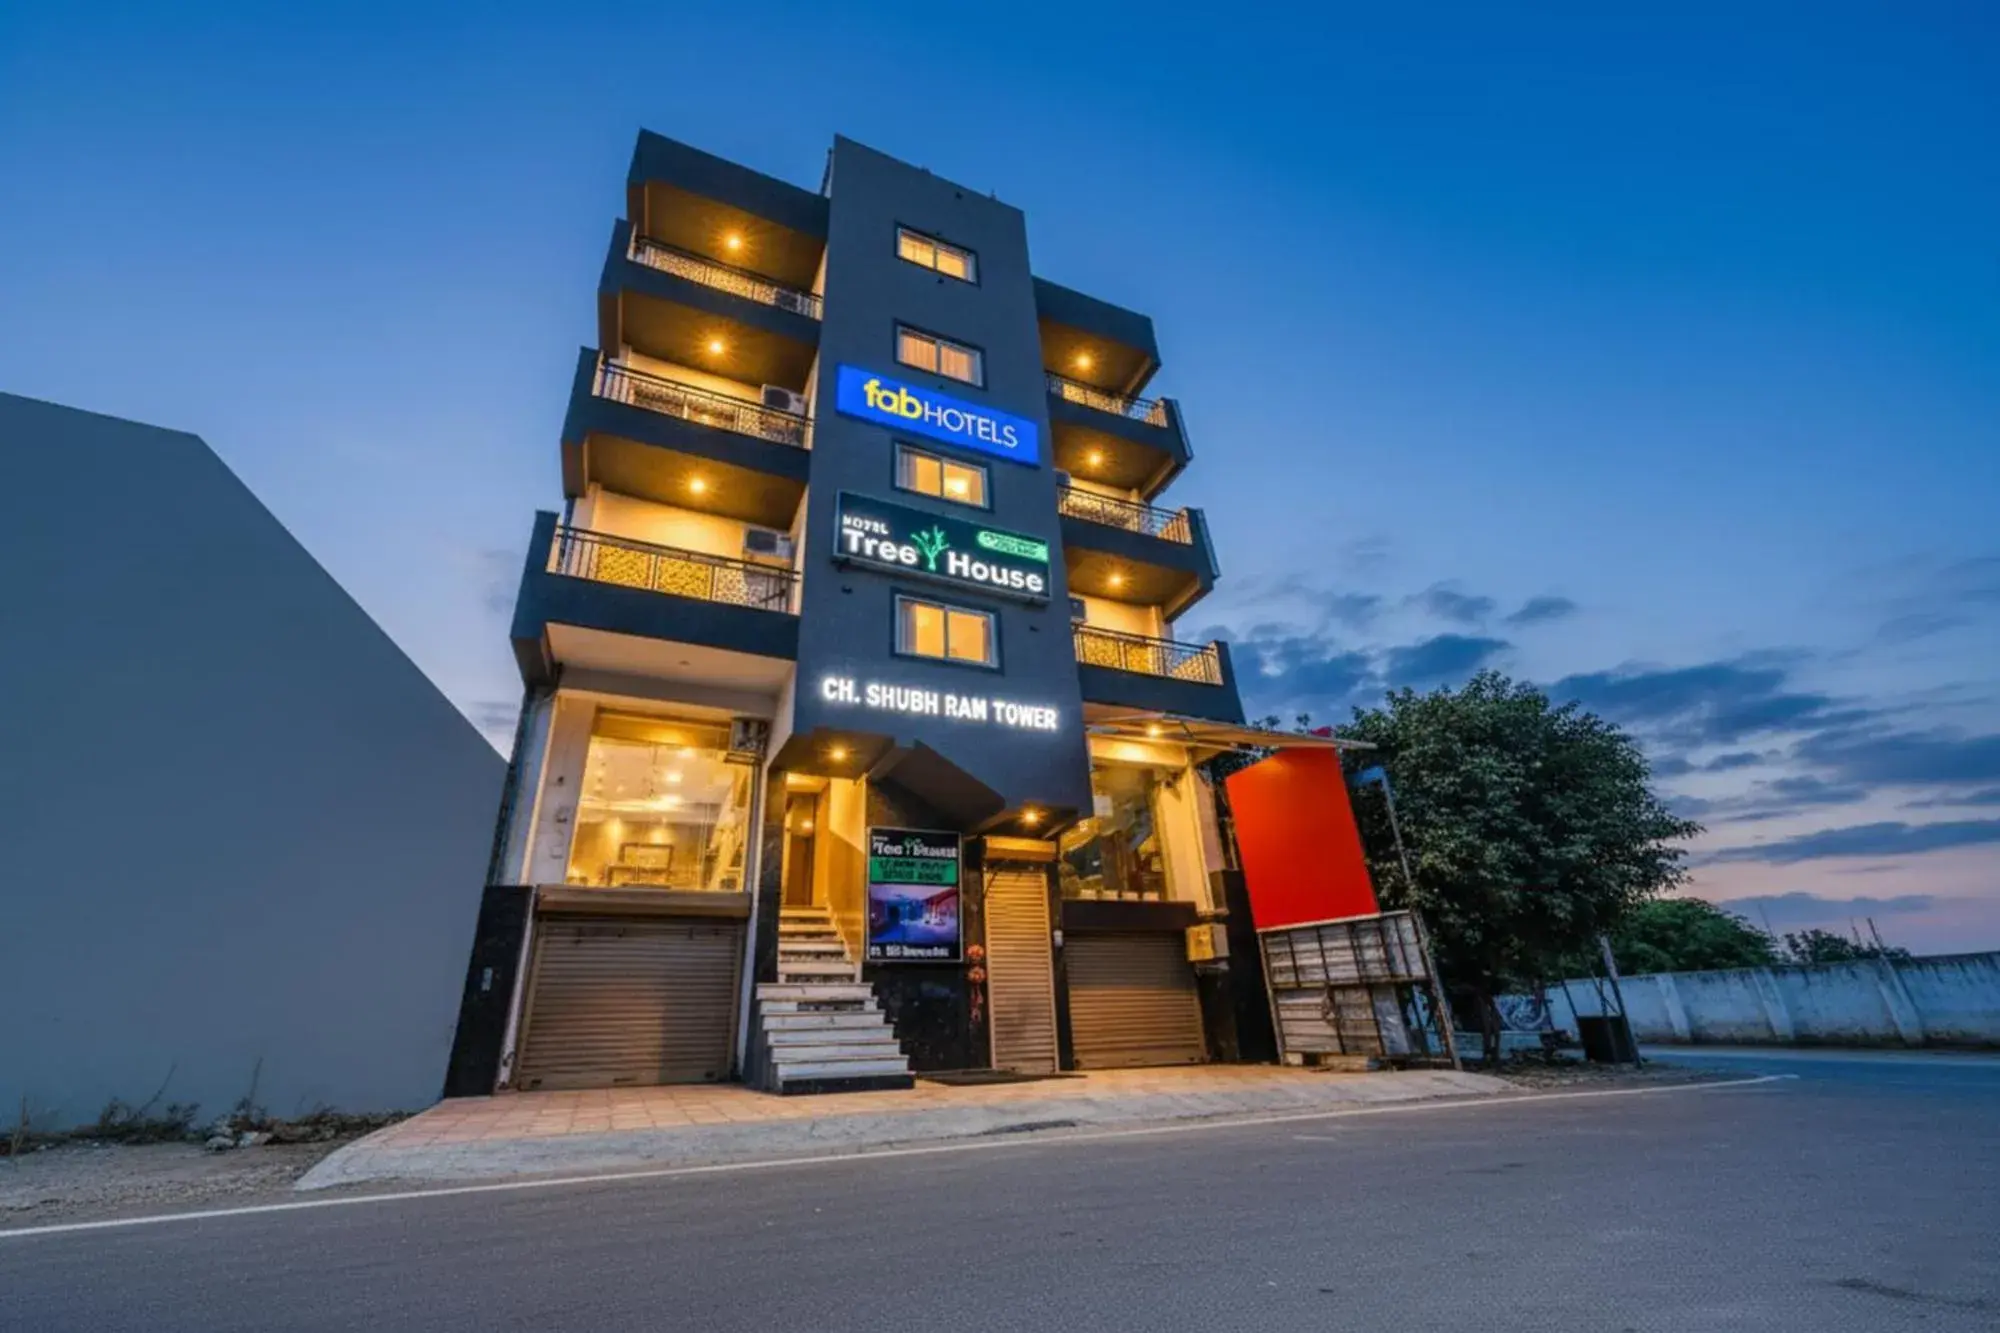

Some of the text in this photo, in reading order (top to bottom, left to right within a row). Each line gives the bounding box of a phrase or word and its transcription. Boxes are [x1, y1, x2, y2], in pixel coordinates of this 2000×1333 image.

[841, 513, 889, 535] HOTEL
[841, 527, 1043, 593] Tree House
[822, 677, 1057, 730] CH. SHUBH RAM TOWER
